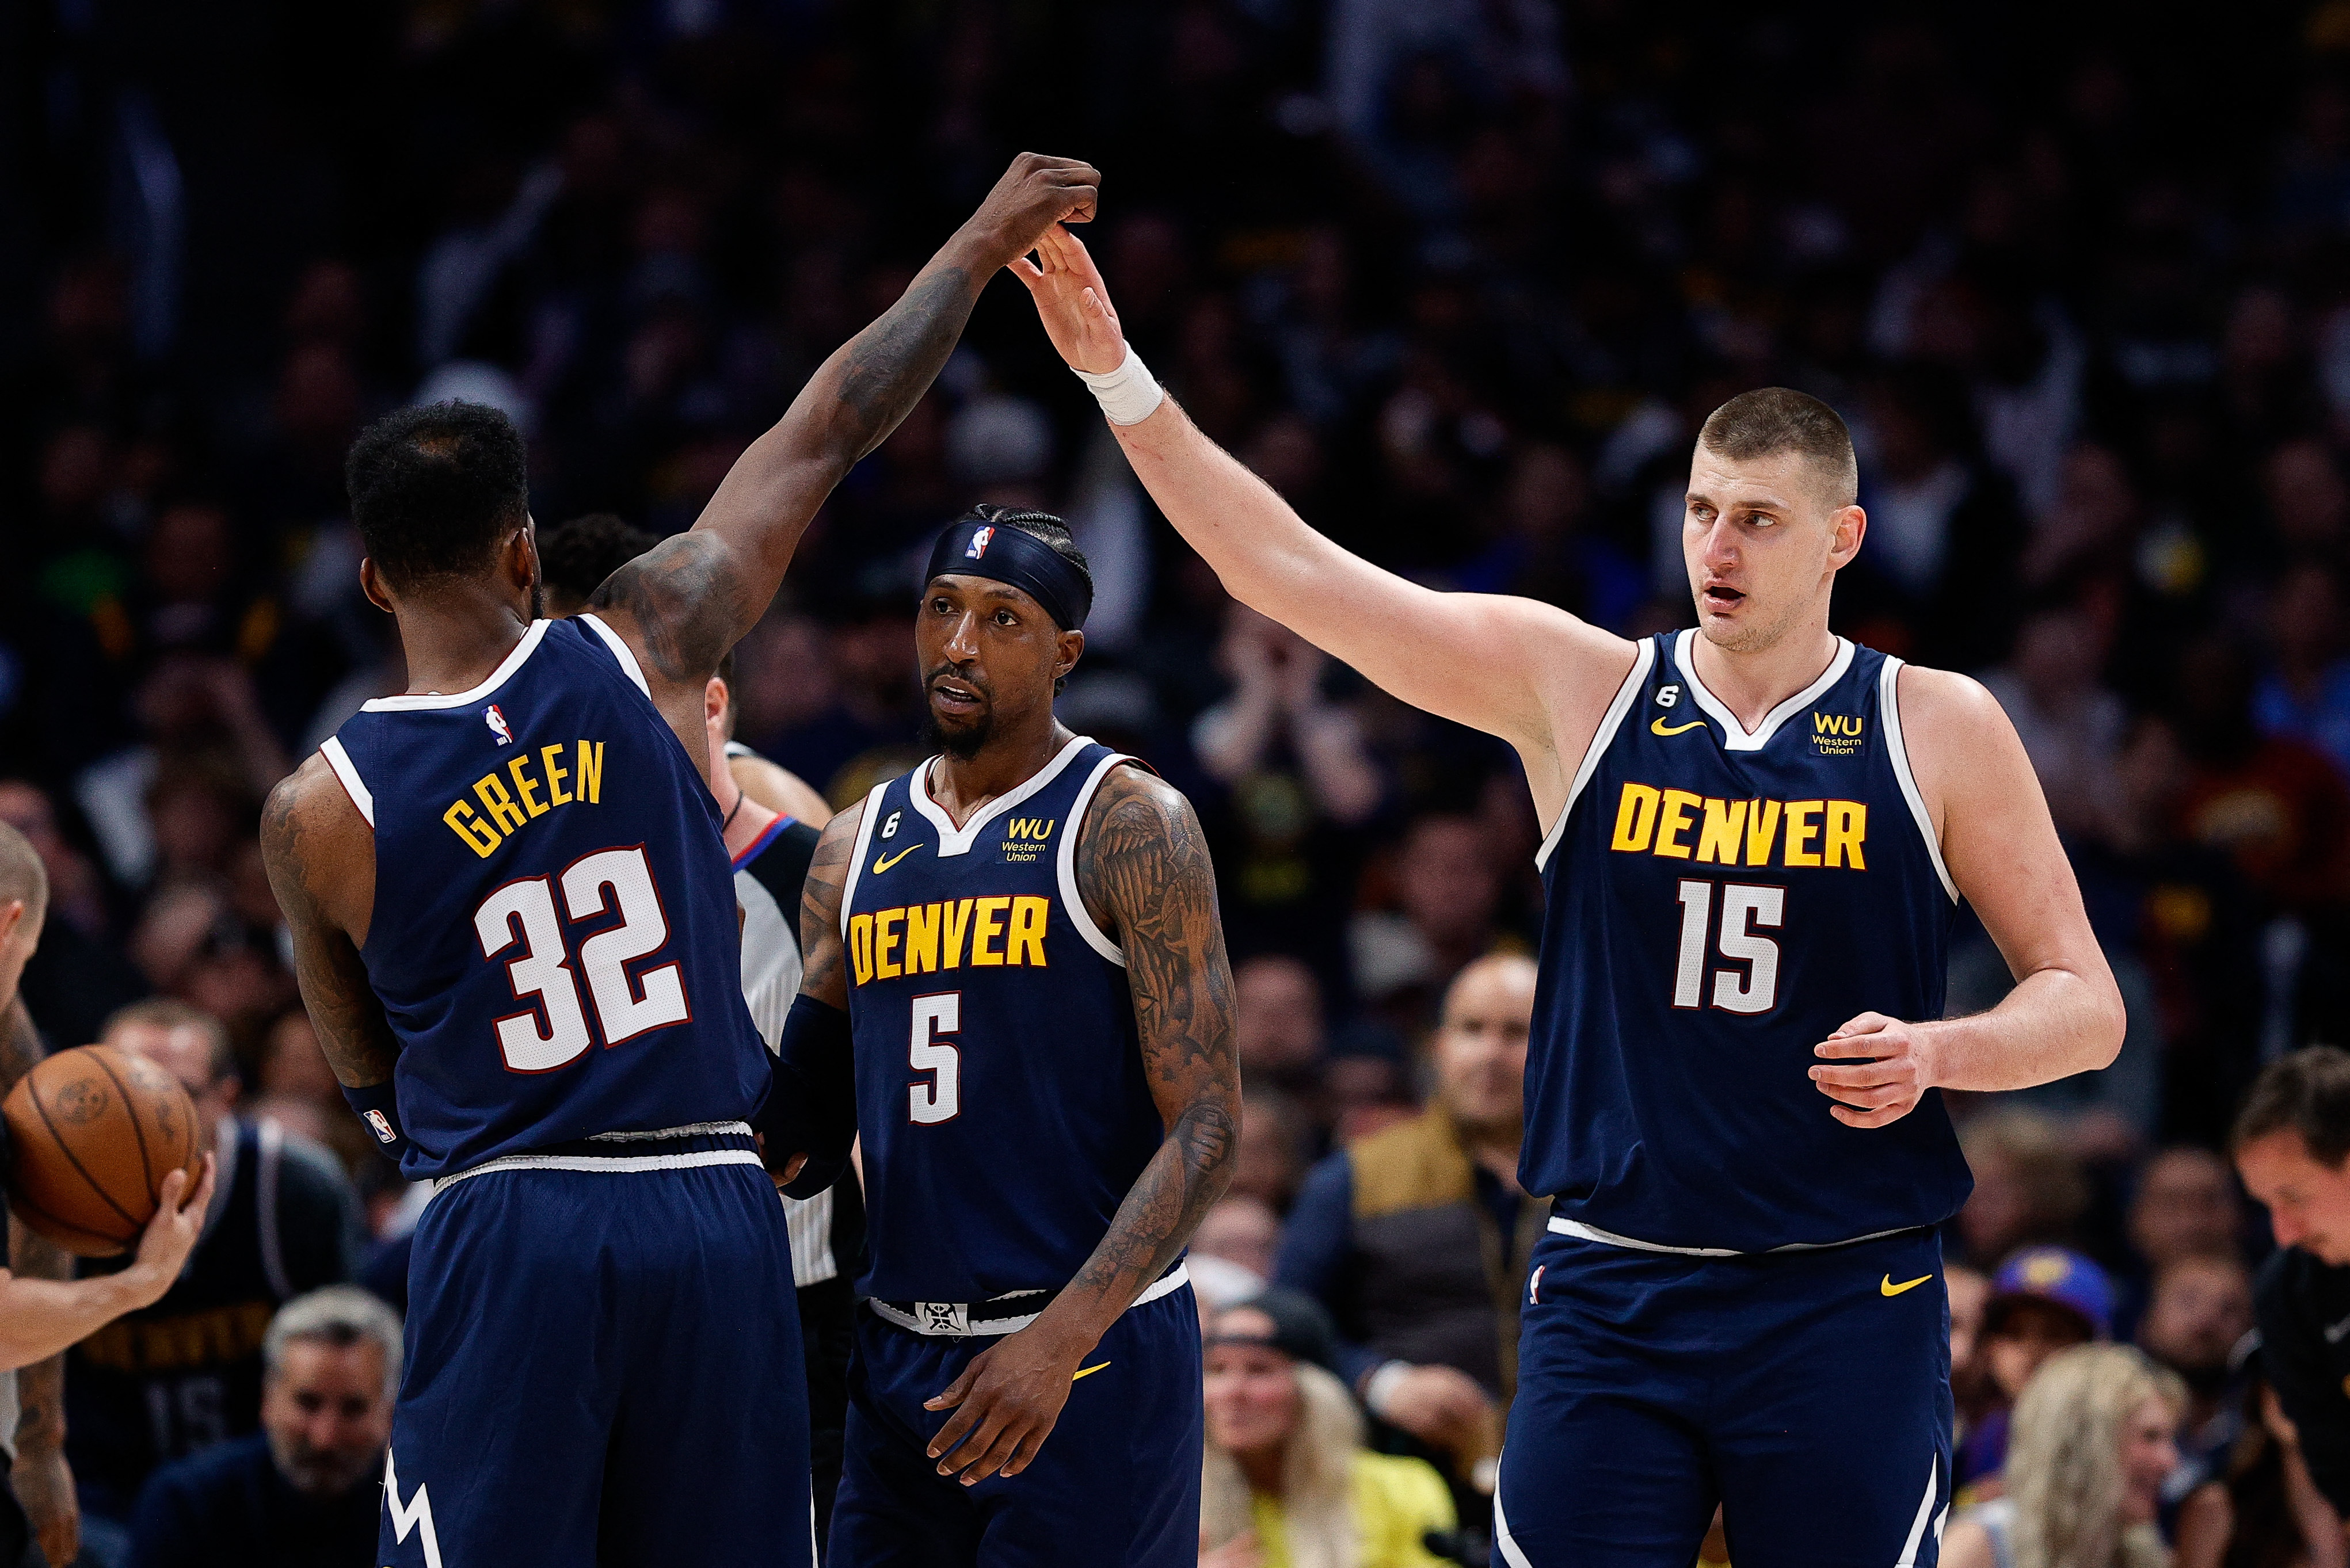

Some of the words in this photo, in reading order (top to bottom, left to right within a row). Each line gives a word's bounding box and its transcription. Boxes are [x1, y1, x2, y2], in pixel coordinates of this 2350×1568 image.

[1655, 685, 1679, 708] 6
[1814, 711, 1862, 736] WU
[1812, 734, 1862, 746] Western
[1820, 745, 1854, 754] Union
[443, 739, 605, 859] GREEN
[881, 811, 901, 838] 6
[1009, 818, 1054, 840] WU
[1610, 781, 1868, 872] DENVER
[1002, 841, 1046, 852] Western
[1007, 852, 1036, 861] Union
[850, 894, 1051, 989] DENVER
[1670, 878, 1788, 1016] 15
[473, 842, 692, 1074] 32
[908, 990, 962, 1126] 5
